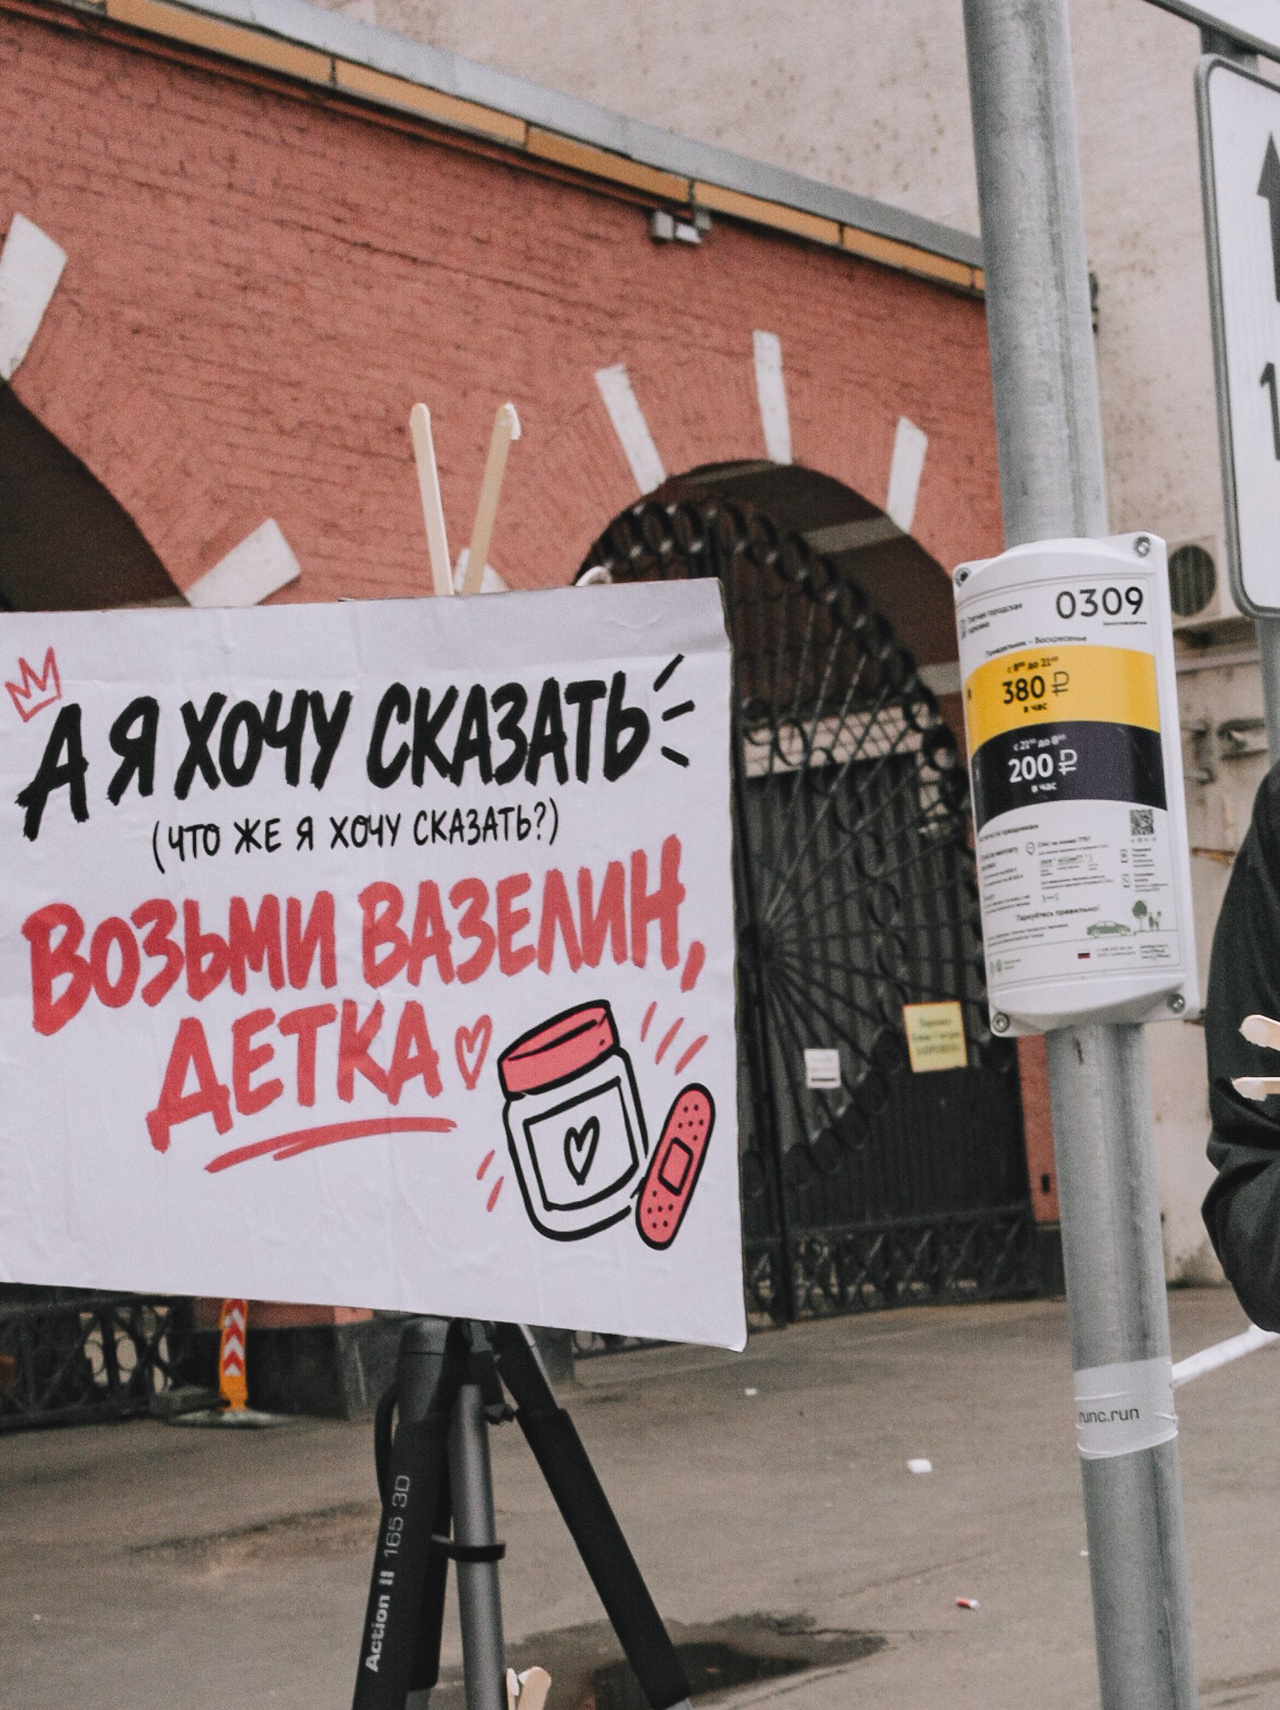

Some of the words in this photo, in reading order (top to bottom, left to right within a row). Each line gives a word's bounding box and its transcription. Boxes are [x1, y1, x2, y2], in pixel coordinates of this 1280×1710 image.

[1056, 586, 1144, 620] 0309
[1002, 675, 1045, 705] 380
[15, 702, 90, 843] А
[106, 695, 160, 807] Я
[173, 688, 354, 801] ХОЧУ
[366, 670, 652, 789] СКАЗАТЬ
[1008, 753, 1054, 783] 200
[152, 820, 221, 875] (ЧТО
[233, 817, 282, 855] ЖЕ
[296, 815, 314, 852] Я
[329, 812, 402, 850] ХОЧУ
[413, 797, 560, 846] СКАЗАТЬ?)
[20, 889, 338, 1037] ВОЗЬМИ
[357, 834, 706, 992] ВАЗЕЛИН,
[145, 998, 444, 1153] ДЕТКА
[392, 1475, 410, 1508] 3D
[384, 1515, 404, 1558] 165
[365, 1594, 391, 1673] Action
